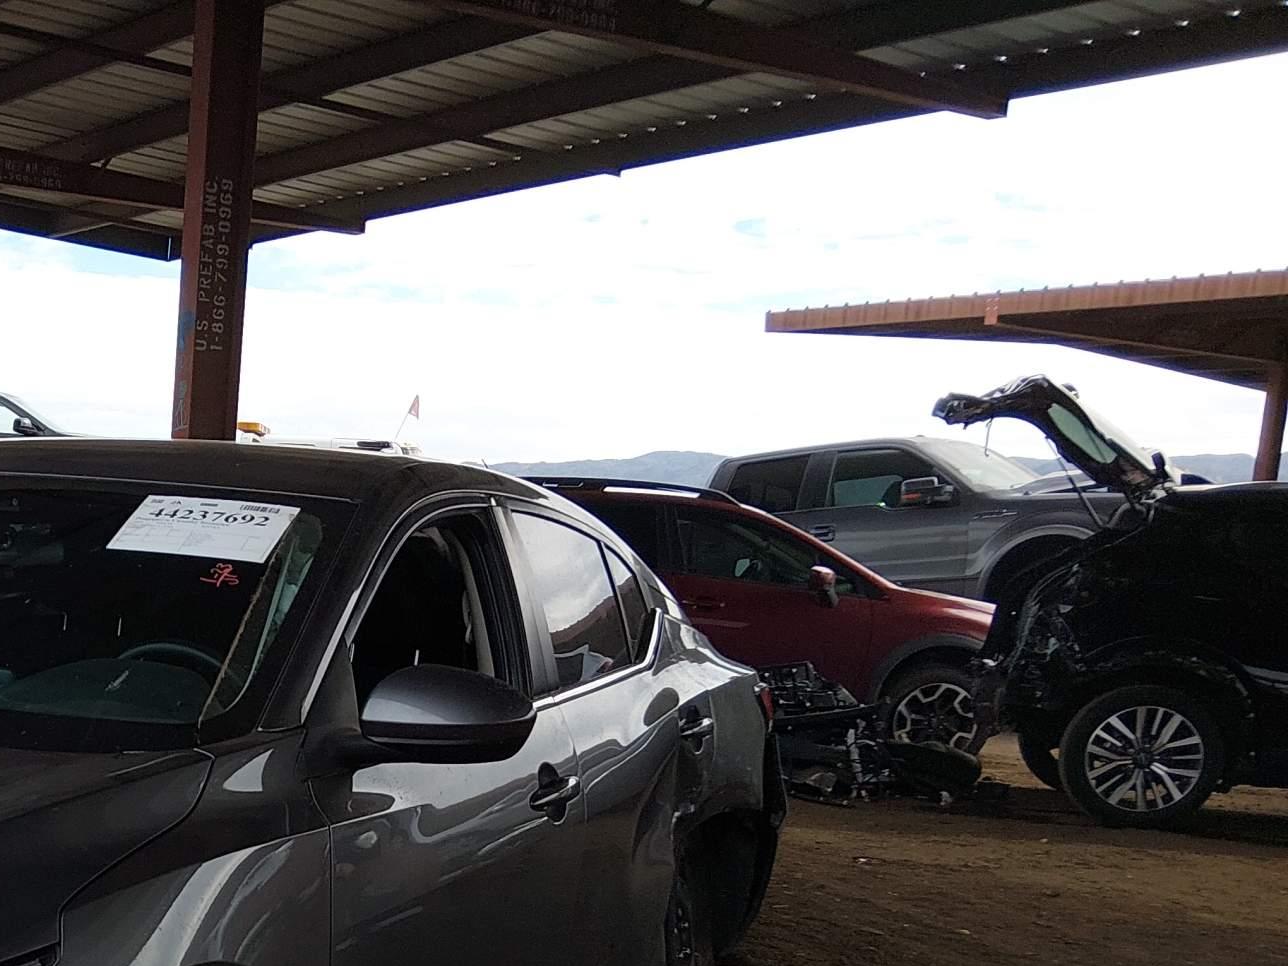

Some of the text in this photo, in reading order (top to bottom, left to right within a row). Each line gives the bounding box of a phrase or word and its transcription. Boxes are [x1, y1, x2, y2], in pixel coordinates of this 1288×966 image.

[195, 175, 219, 352] U.S. PREFAB INC.
[210, 177, 233, 352] 1-866-799-0969
[150, 507, 270, 527] 44237692
